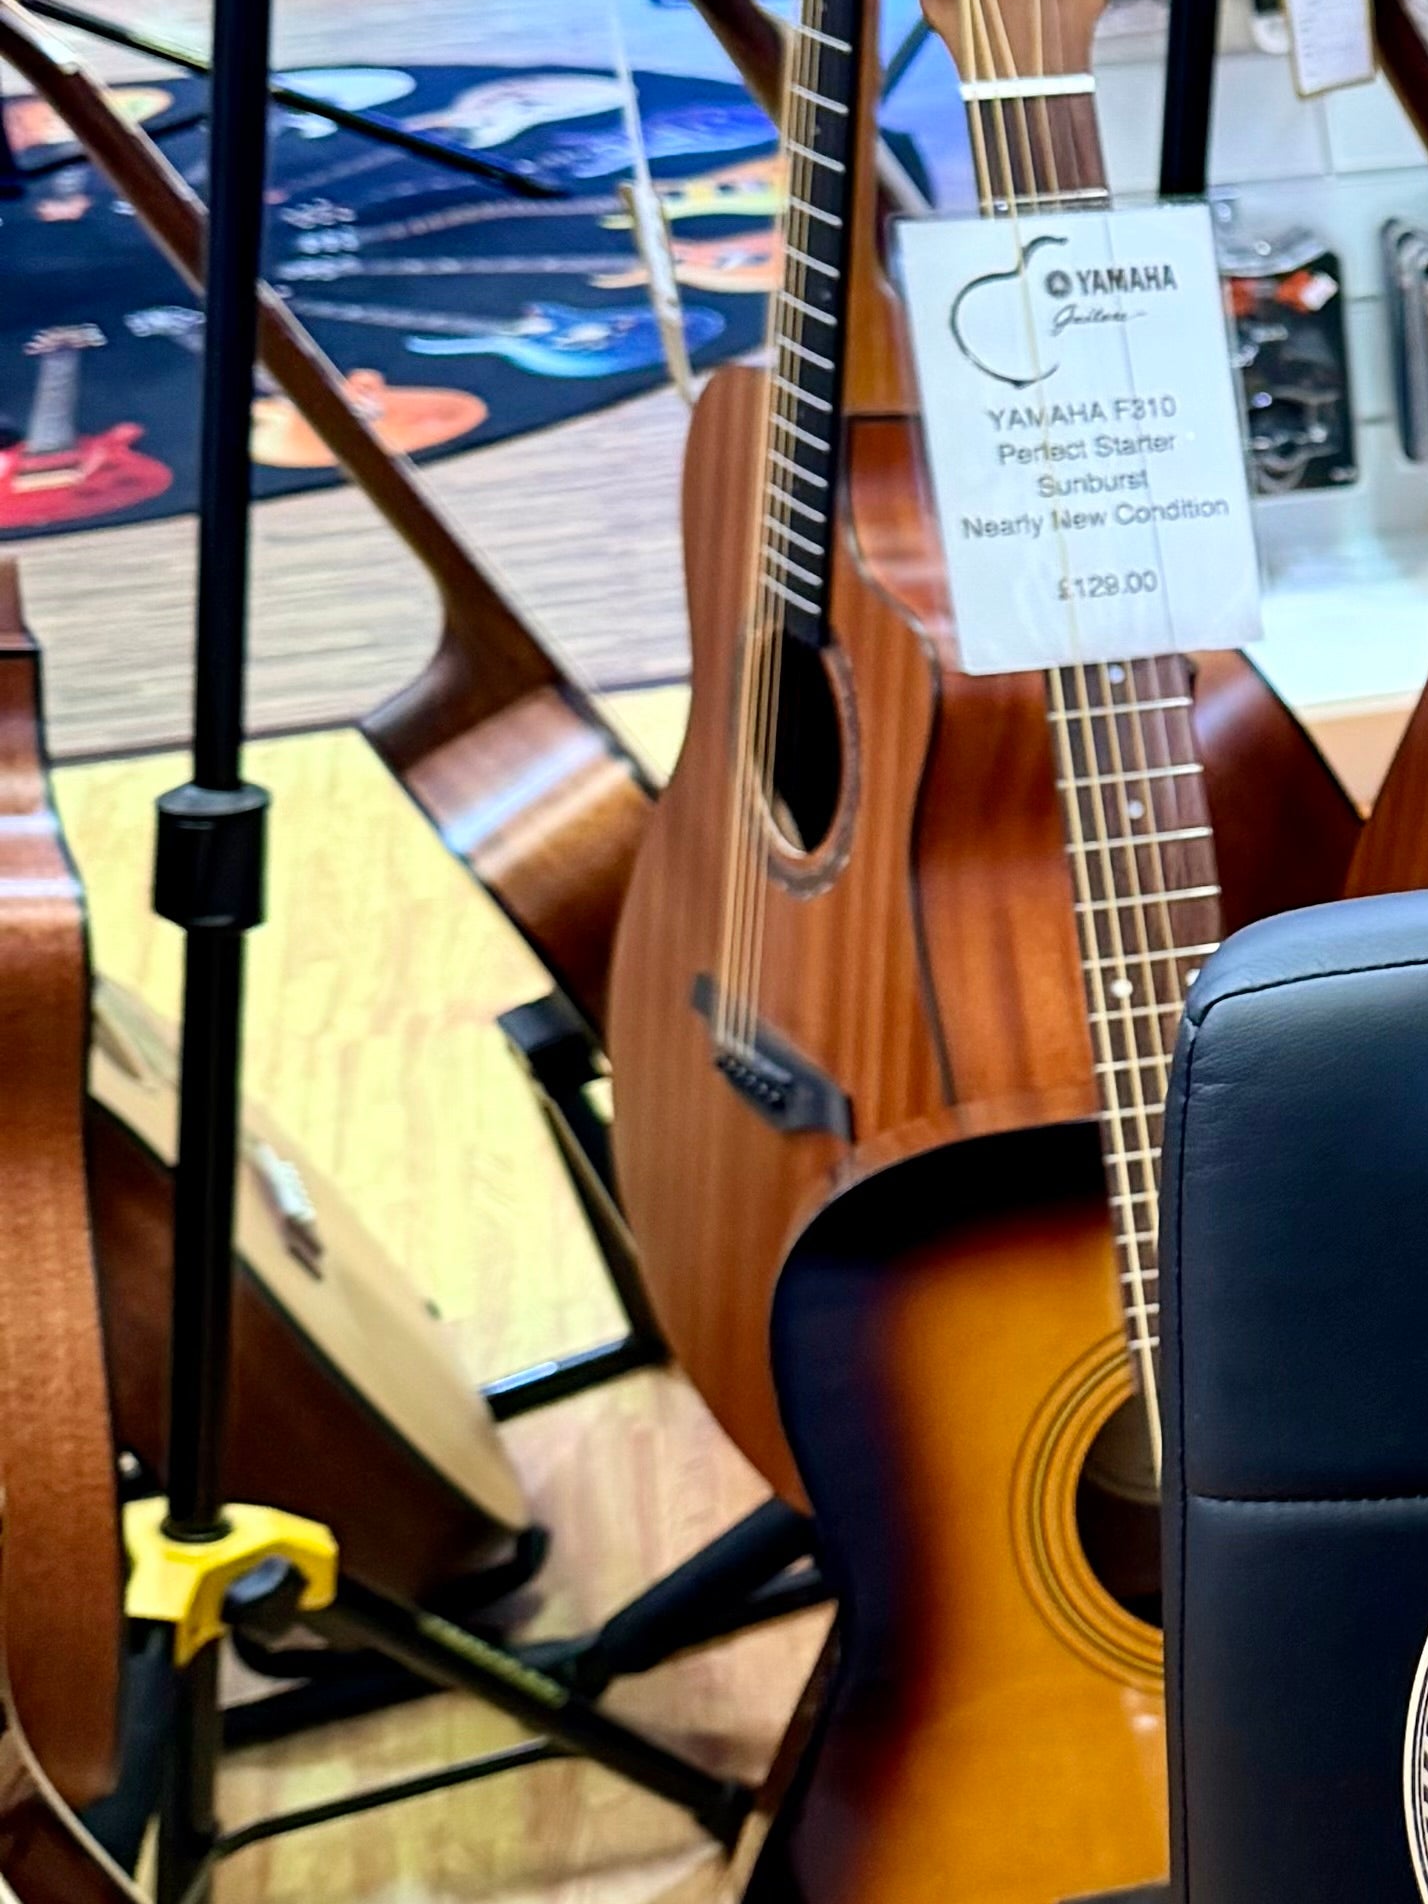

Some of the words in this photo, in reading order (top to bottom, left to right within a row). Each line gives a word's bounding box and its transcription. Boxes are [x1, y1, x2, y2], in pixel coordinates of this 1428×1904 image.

[1075, 265, 1179, 296] YAMAHA
[986, 402, 1108, 431] YAMAHA
[1112, 395, 1178, 422] F310
[998, 441, 1088, 466] Perfect
[1094, 434, 1178, 459] Starter
[1037, 469, 1149, 498] Sunburst
[961, 510, 1044, 540] Nearly
[1051, 508, 1109, 531] New
[1116, 497, 1232, 527] Condition
[1057, 569, 1158, 602] £129.00
